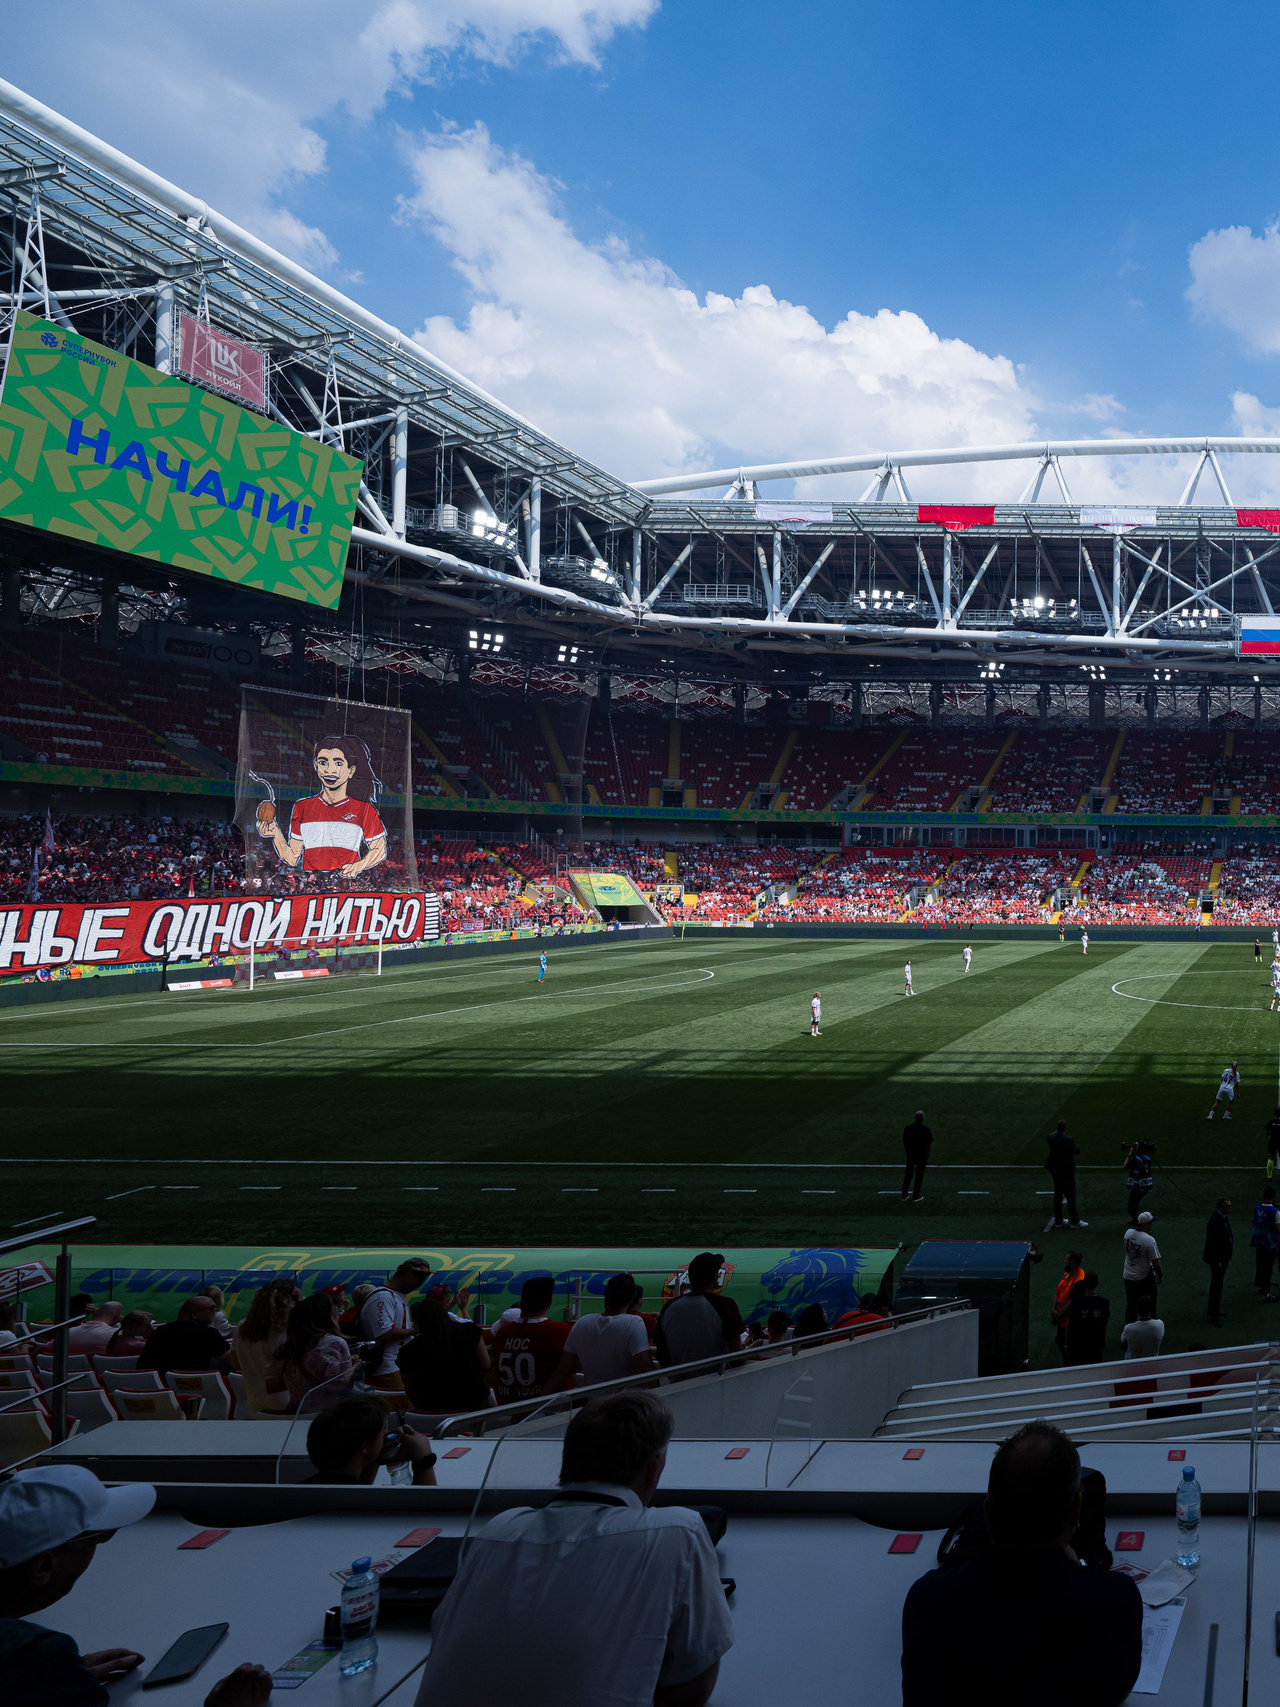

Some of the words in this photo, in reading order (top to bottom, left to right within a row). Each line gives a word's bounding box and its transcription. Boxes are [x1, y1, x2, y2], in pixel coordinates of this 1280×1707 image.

[60, 346, 96, 366] РОССИИ
[62, 339, 117, 367] СУПЕРКУБОК
[205, 370, 242, 391] ЛУКОЙЛ
[65, 417, 313, 535] НАЧАЛИ!
[203, 642, 253, 665] 100
[550, 803, 636, 817] СУПЕРКУБОК
[640, 808, 691, 819] РОССИИ
[840, 813, 908, 822] СУПЕРКУБОК
[911, 813, 952, 822] РОССИИ
[955, 814, 979, 822] 2026
[1090, 815, 1159, 824] СУПЕРКУБОК
[1160, 816, 1202, 825] РОССИИ
[143, 897, 293, 961] ОДНОЙ
[302, 895, 421, 941] НИТЬЮ
[498, 1352, 537, 1387] 50
[1121, 1533, 1138, 1546] 4
